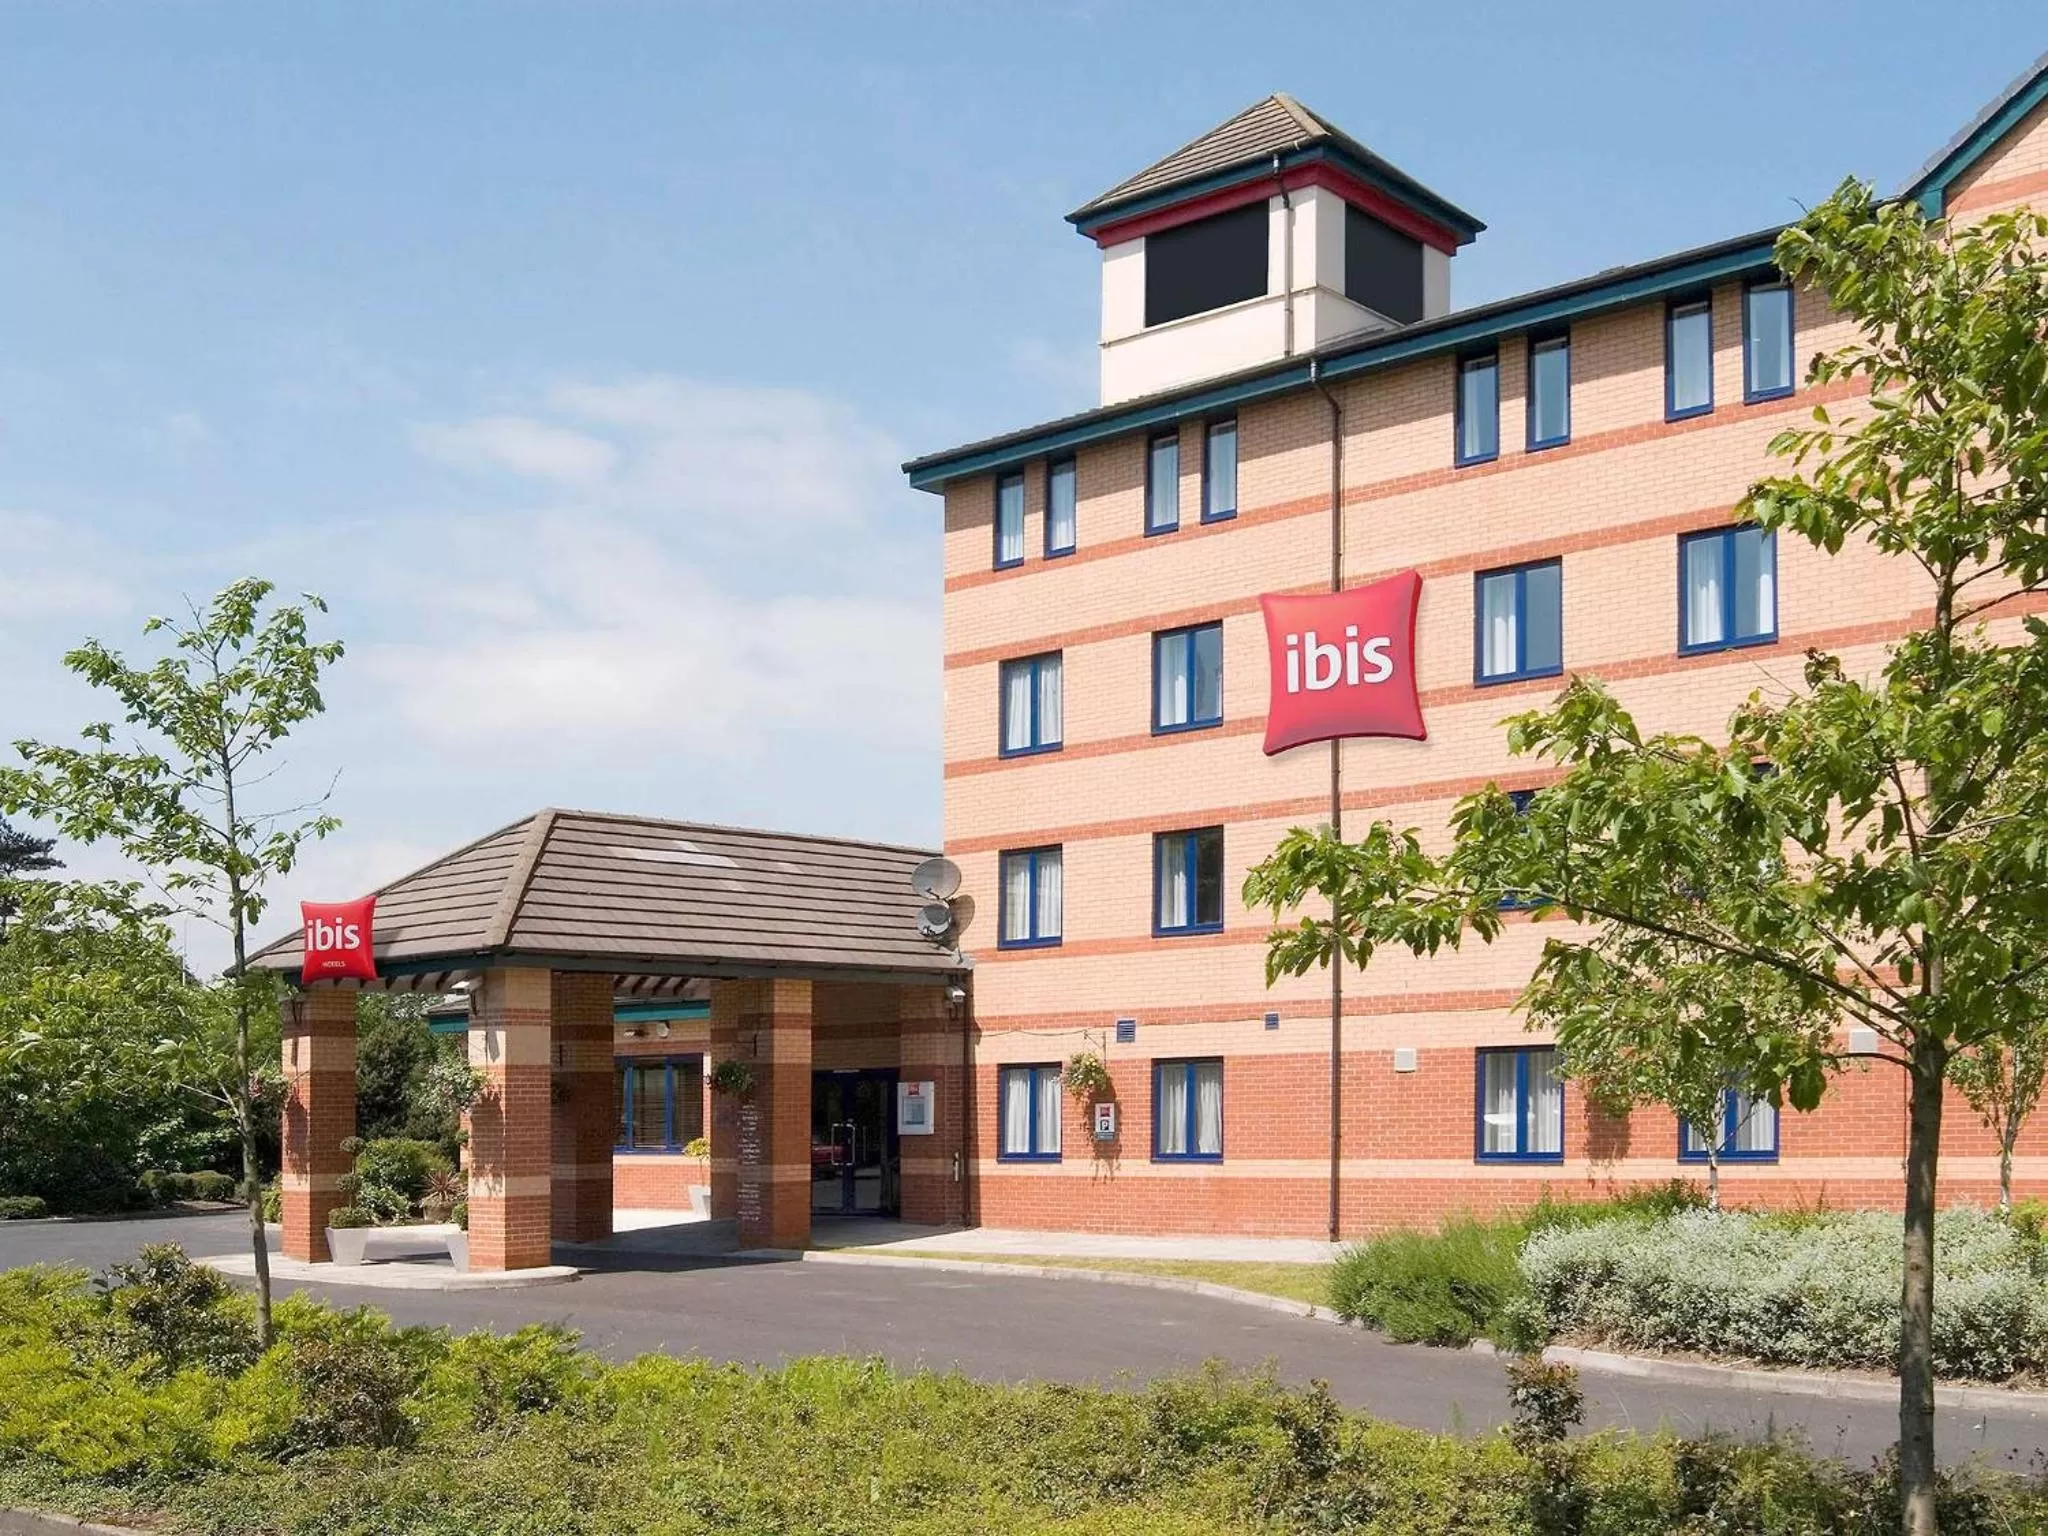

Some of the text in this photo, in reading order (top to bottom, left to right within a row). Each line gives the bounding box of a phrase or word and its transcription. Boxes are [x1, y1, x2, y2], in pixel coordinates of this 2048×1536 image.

[1285, 625, 1394, 693] ibis
[306, 917, 360, 951] ibis
[1101, 1120, 1108, 1130] P
